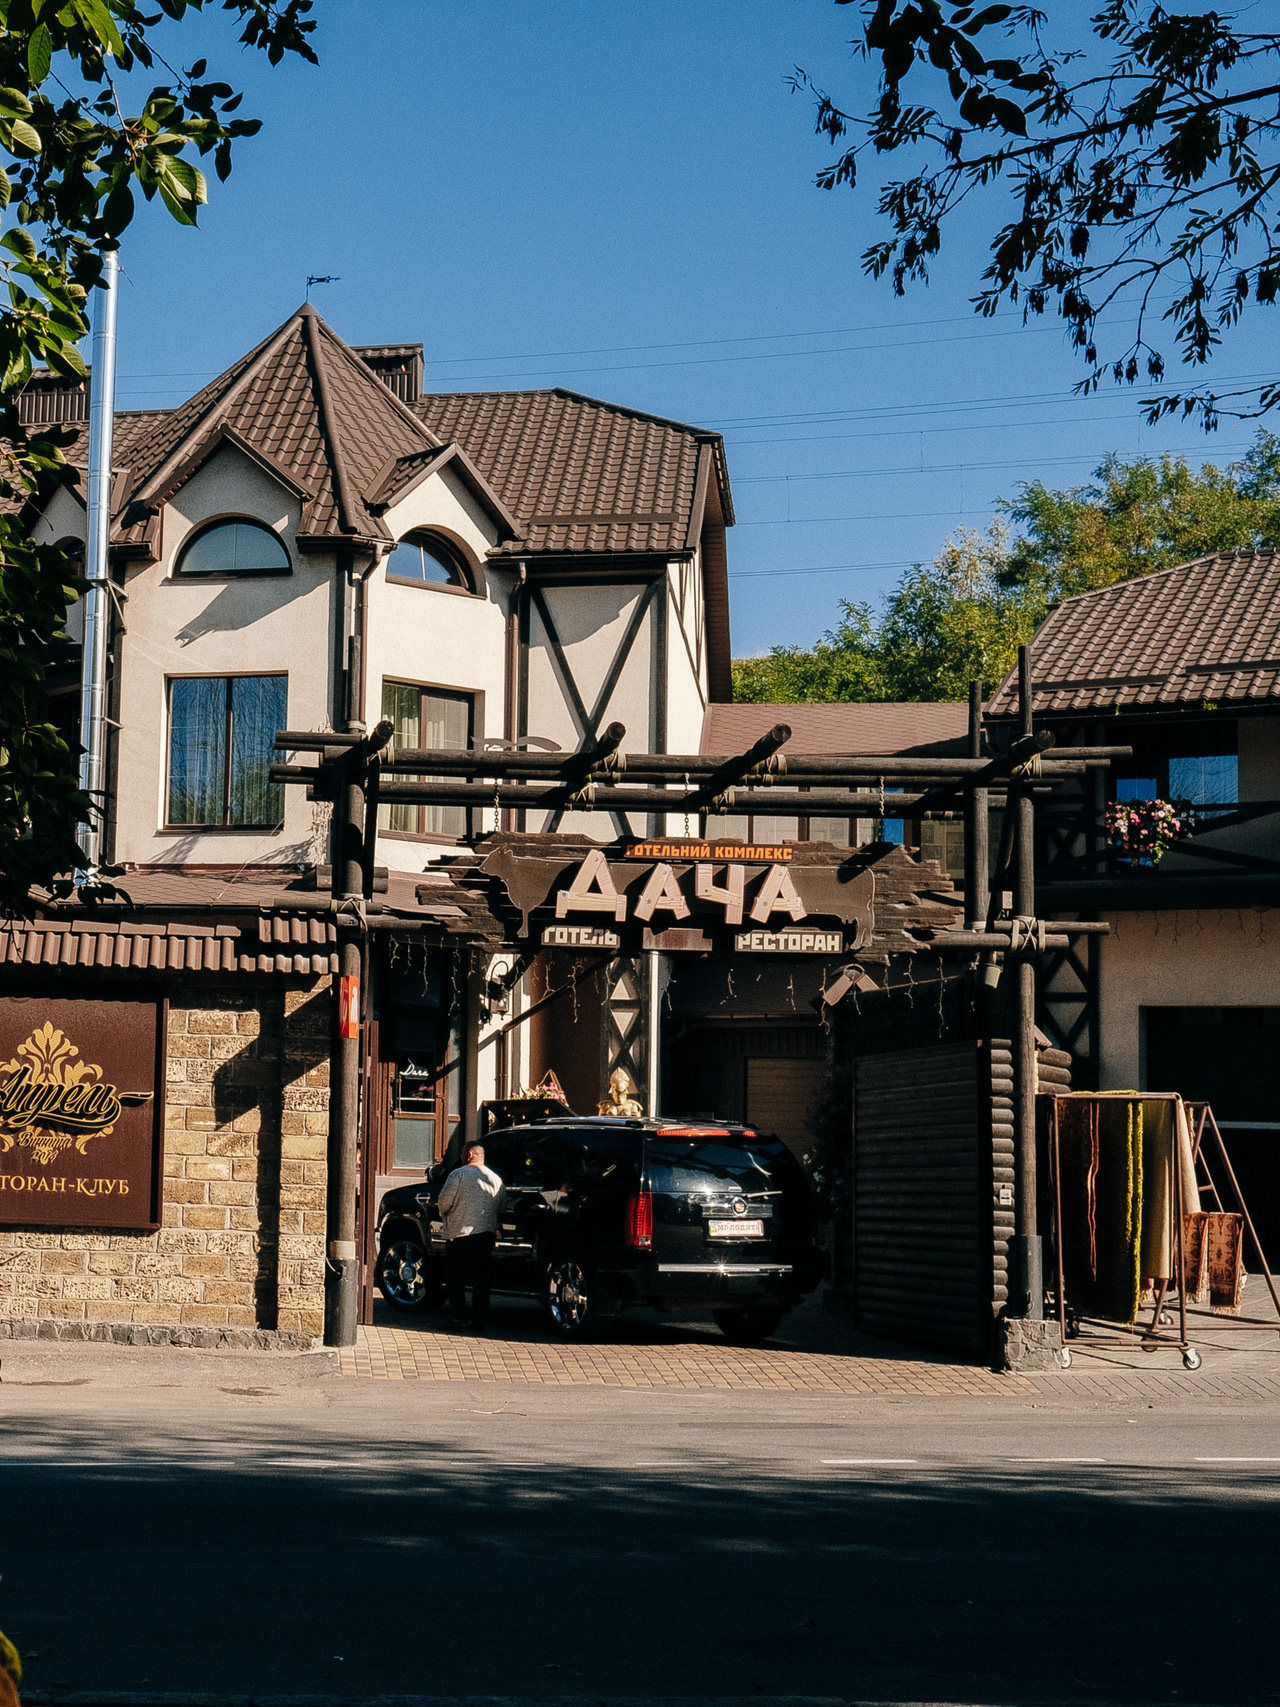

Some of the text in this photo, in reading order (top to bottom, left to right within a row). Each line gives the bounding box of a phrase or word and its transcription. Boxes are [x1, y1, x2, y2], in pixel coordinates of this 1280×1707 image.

[626, 844, 792, 860] ГОТЕЛЬНИЙ КОМПЛЕКС
[555, 849, 808, 925] ДАЧА
[544, 927, 617, 945] ГОТЕЛЬ
[738, 933, 840, 952] РЕСТОРАН
